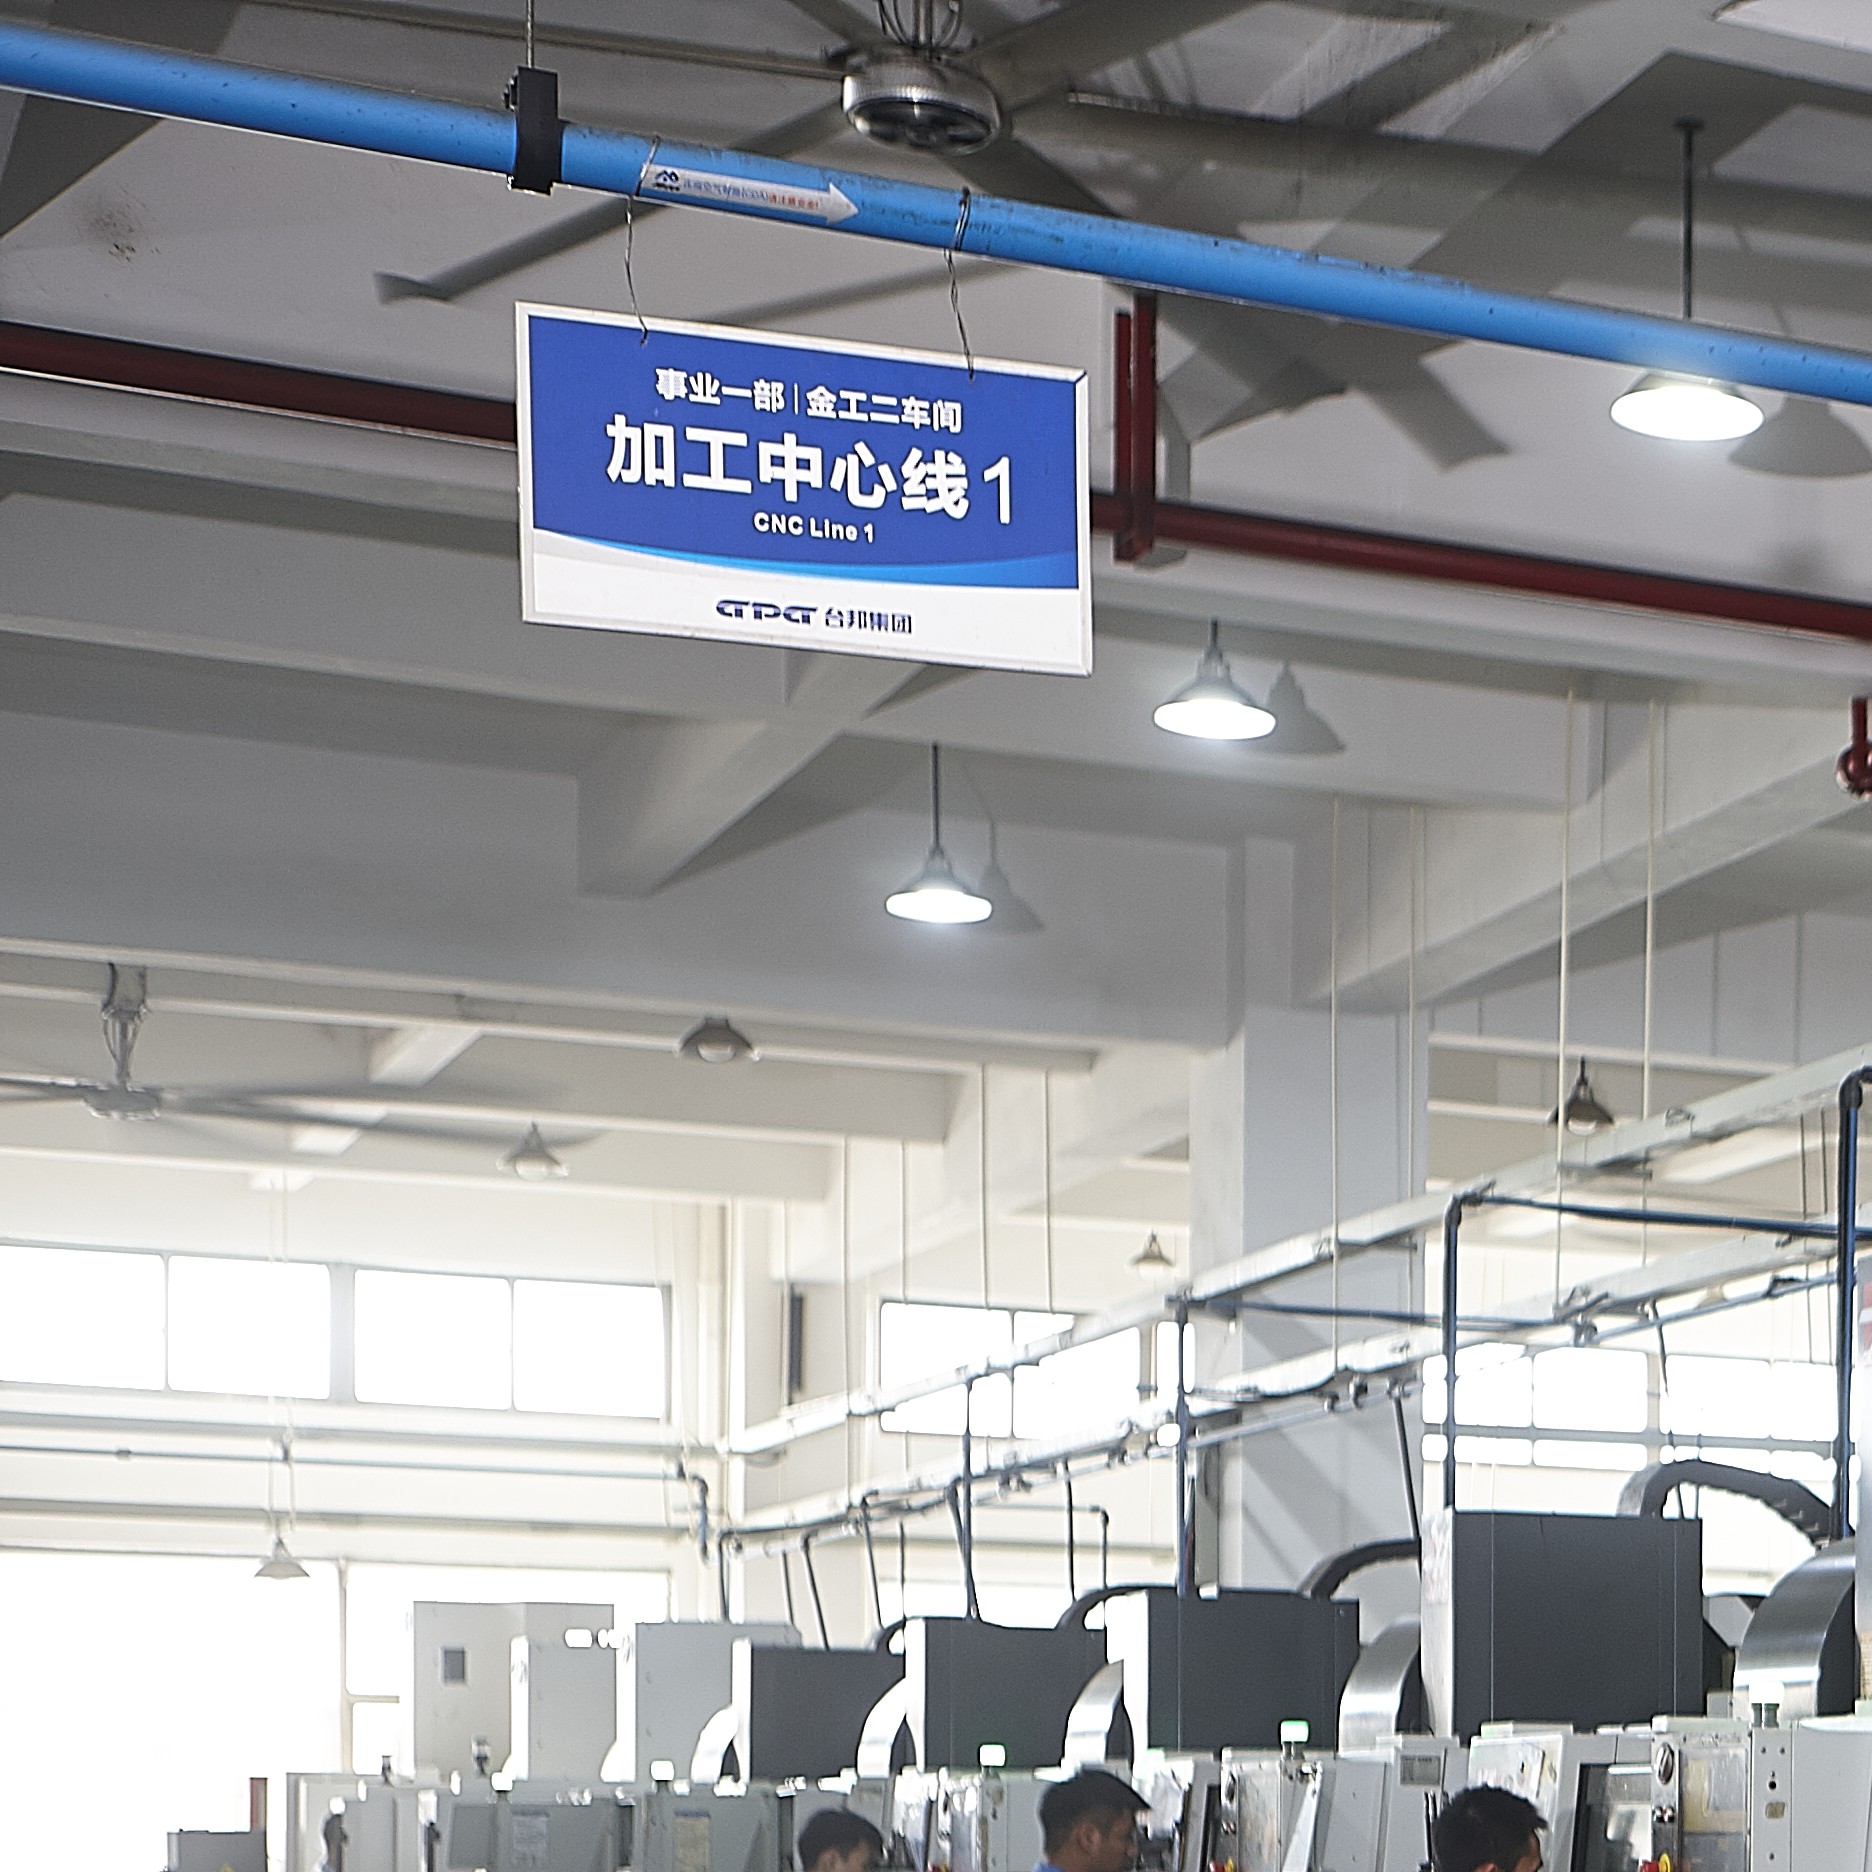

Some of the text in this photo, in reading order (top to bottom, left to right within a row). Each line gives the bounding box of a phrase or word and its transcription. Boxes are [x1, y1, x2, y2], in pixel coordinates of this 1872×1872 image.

[655, 367, 962, 434] 事业一部 金工二车间
[753, 511, 875, 544] CNC Line 1
[825, 606, 912, 634] 台邦集团
